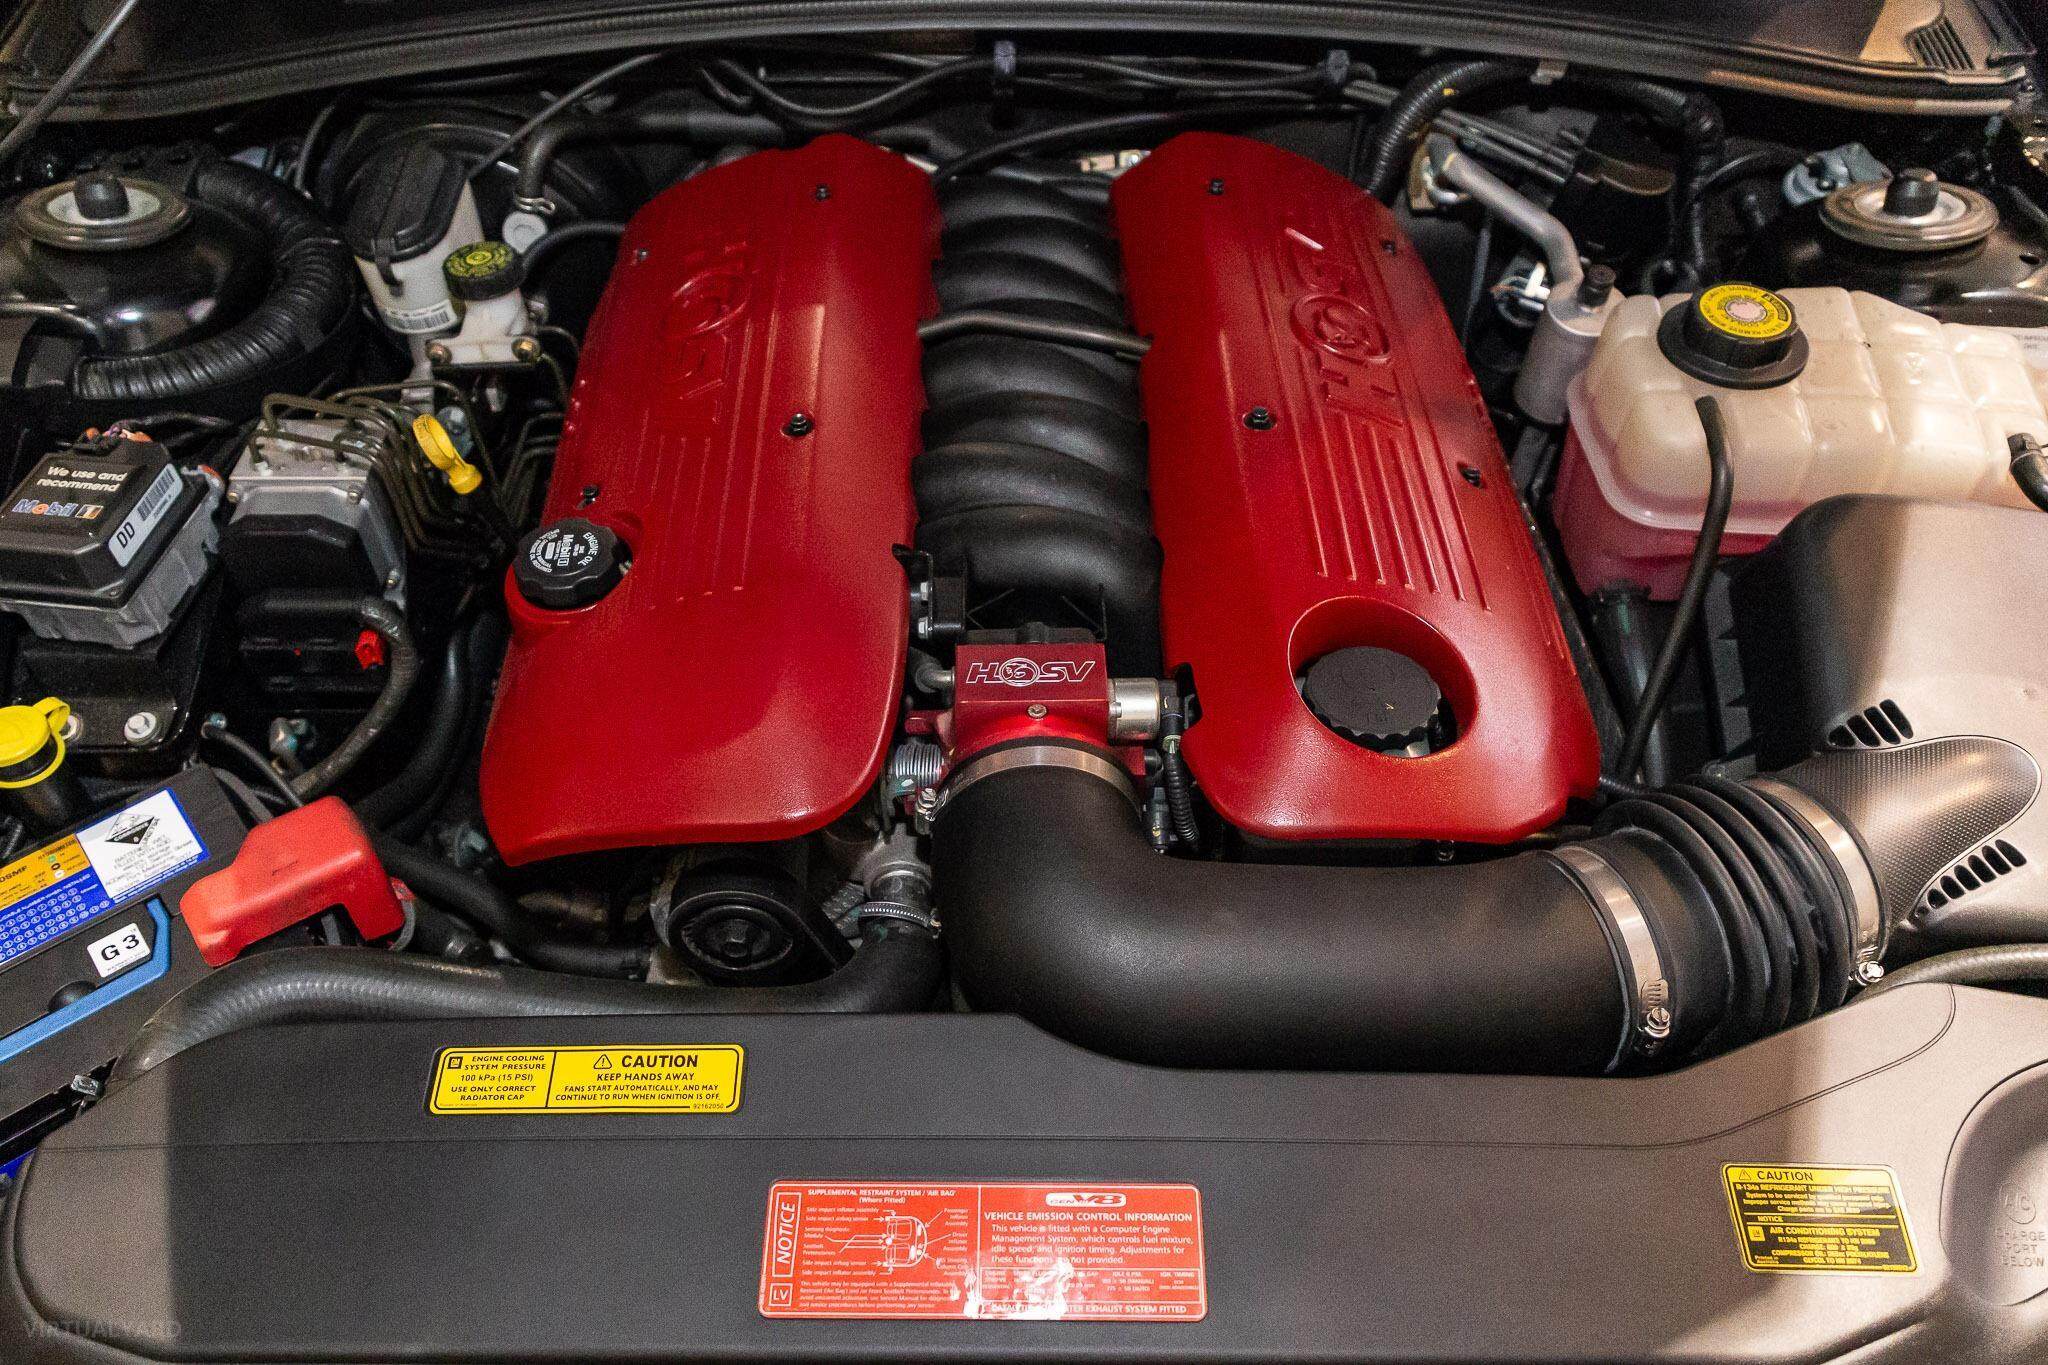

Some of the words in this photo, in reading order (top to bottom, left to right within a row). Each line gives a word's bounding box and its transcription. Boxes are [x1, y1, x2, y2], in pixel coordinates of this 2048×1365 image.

[47, 466, 69, 476] We
[71, 469, 96, 479] use
[98, 471, 127, 482] and
[37, 477, 120, 492] recommend
[12, 499, 78, 517] Mobil
[116, 522, 136, 548] DD
[560, 534, 575, 558] Mobil
[583, 532, 599, 556] ENGINE
[578, 556, 593, 567] OIL
[621, 1054, 698, 1068] CAUTION
[498, 1074, 512, 1082] (15
[514, 1073, 533, 1082] PSI)
[596, 1073, 621, 1081] KEEP
[624, 1073, 662, 1081] HANDS
[665, 1073, 695, 1081] AWAY
[564, 1085, 585, 1093] FANS
[613, 1084, 681, 1092] AUTOMATICALLY,
[1757, 1171, 1813, 1181] CAUTION
[983, 1212, 1024, 1221] VEHICLE
[1026, 1212, 1074, 1221] EMISSION
[1076, 1212, 1121, 1221] CONTROL
[1124, 1212, 1193, 1222] INFORMATION
[777, 1202, 796, 1264] NOTICE
[991, 1225, 1007, 1233] This
[1009, 1225, 1038, 1233] vehicle
[1048, 1225, 1070, 1233] fitted
[1072, 1225, 1091, 1233] with
[1100, 1225, 1140, 1235] Computer
[1142, 1225, 1170, 1235] Engine
[1769, 1226, 1784, 1234] AIR
[1785, 1227, 1845, 1236] CONDITIONING
[1846, 1228, 1880, 1236] SYSTEM
[991, 1235, 1045, 1245] Management
[1081, 1235, 1105, 1244] which
[1108, 1235, 1140, 1244] controls
[1142, 1235, 1158, 1244] fuel
[1160, 1236, 1194, 1246] mixture,
[1119, 1246, 1171, 1255] Adjustments
[1173, 1246, 1185, 1254] for
[991, 1255, 1013, 1263] these
[1071, 1256, 1085, 1264] not
[1087, 1256, 1125, 1265] provided.
[773, 1290, 789, 1301] LV
[1086, 1305, 1123, 1313] EXHAUST
[1125, 1305, 1157, 1313] SYSTEM
[1160, 1305, 1187, 1313] FITTED
